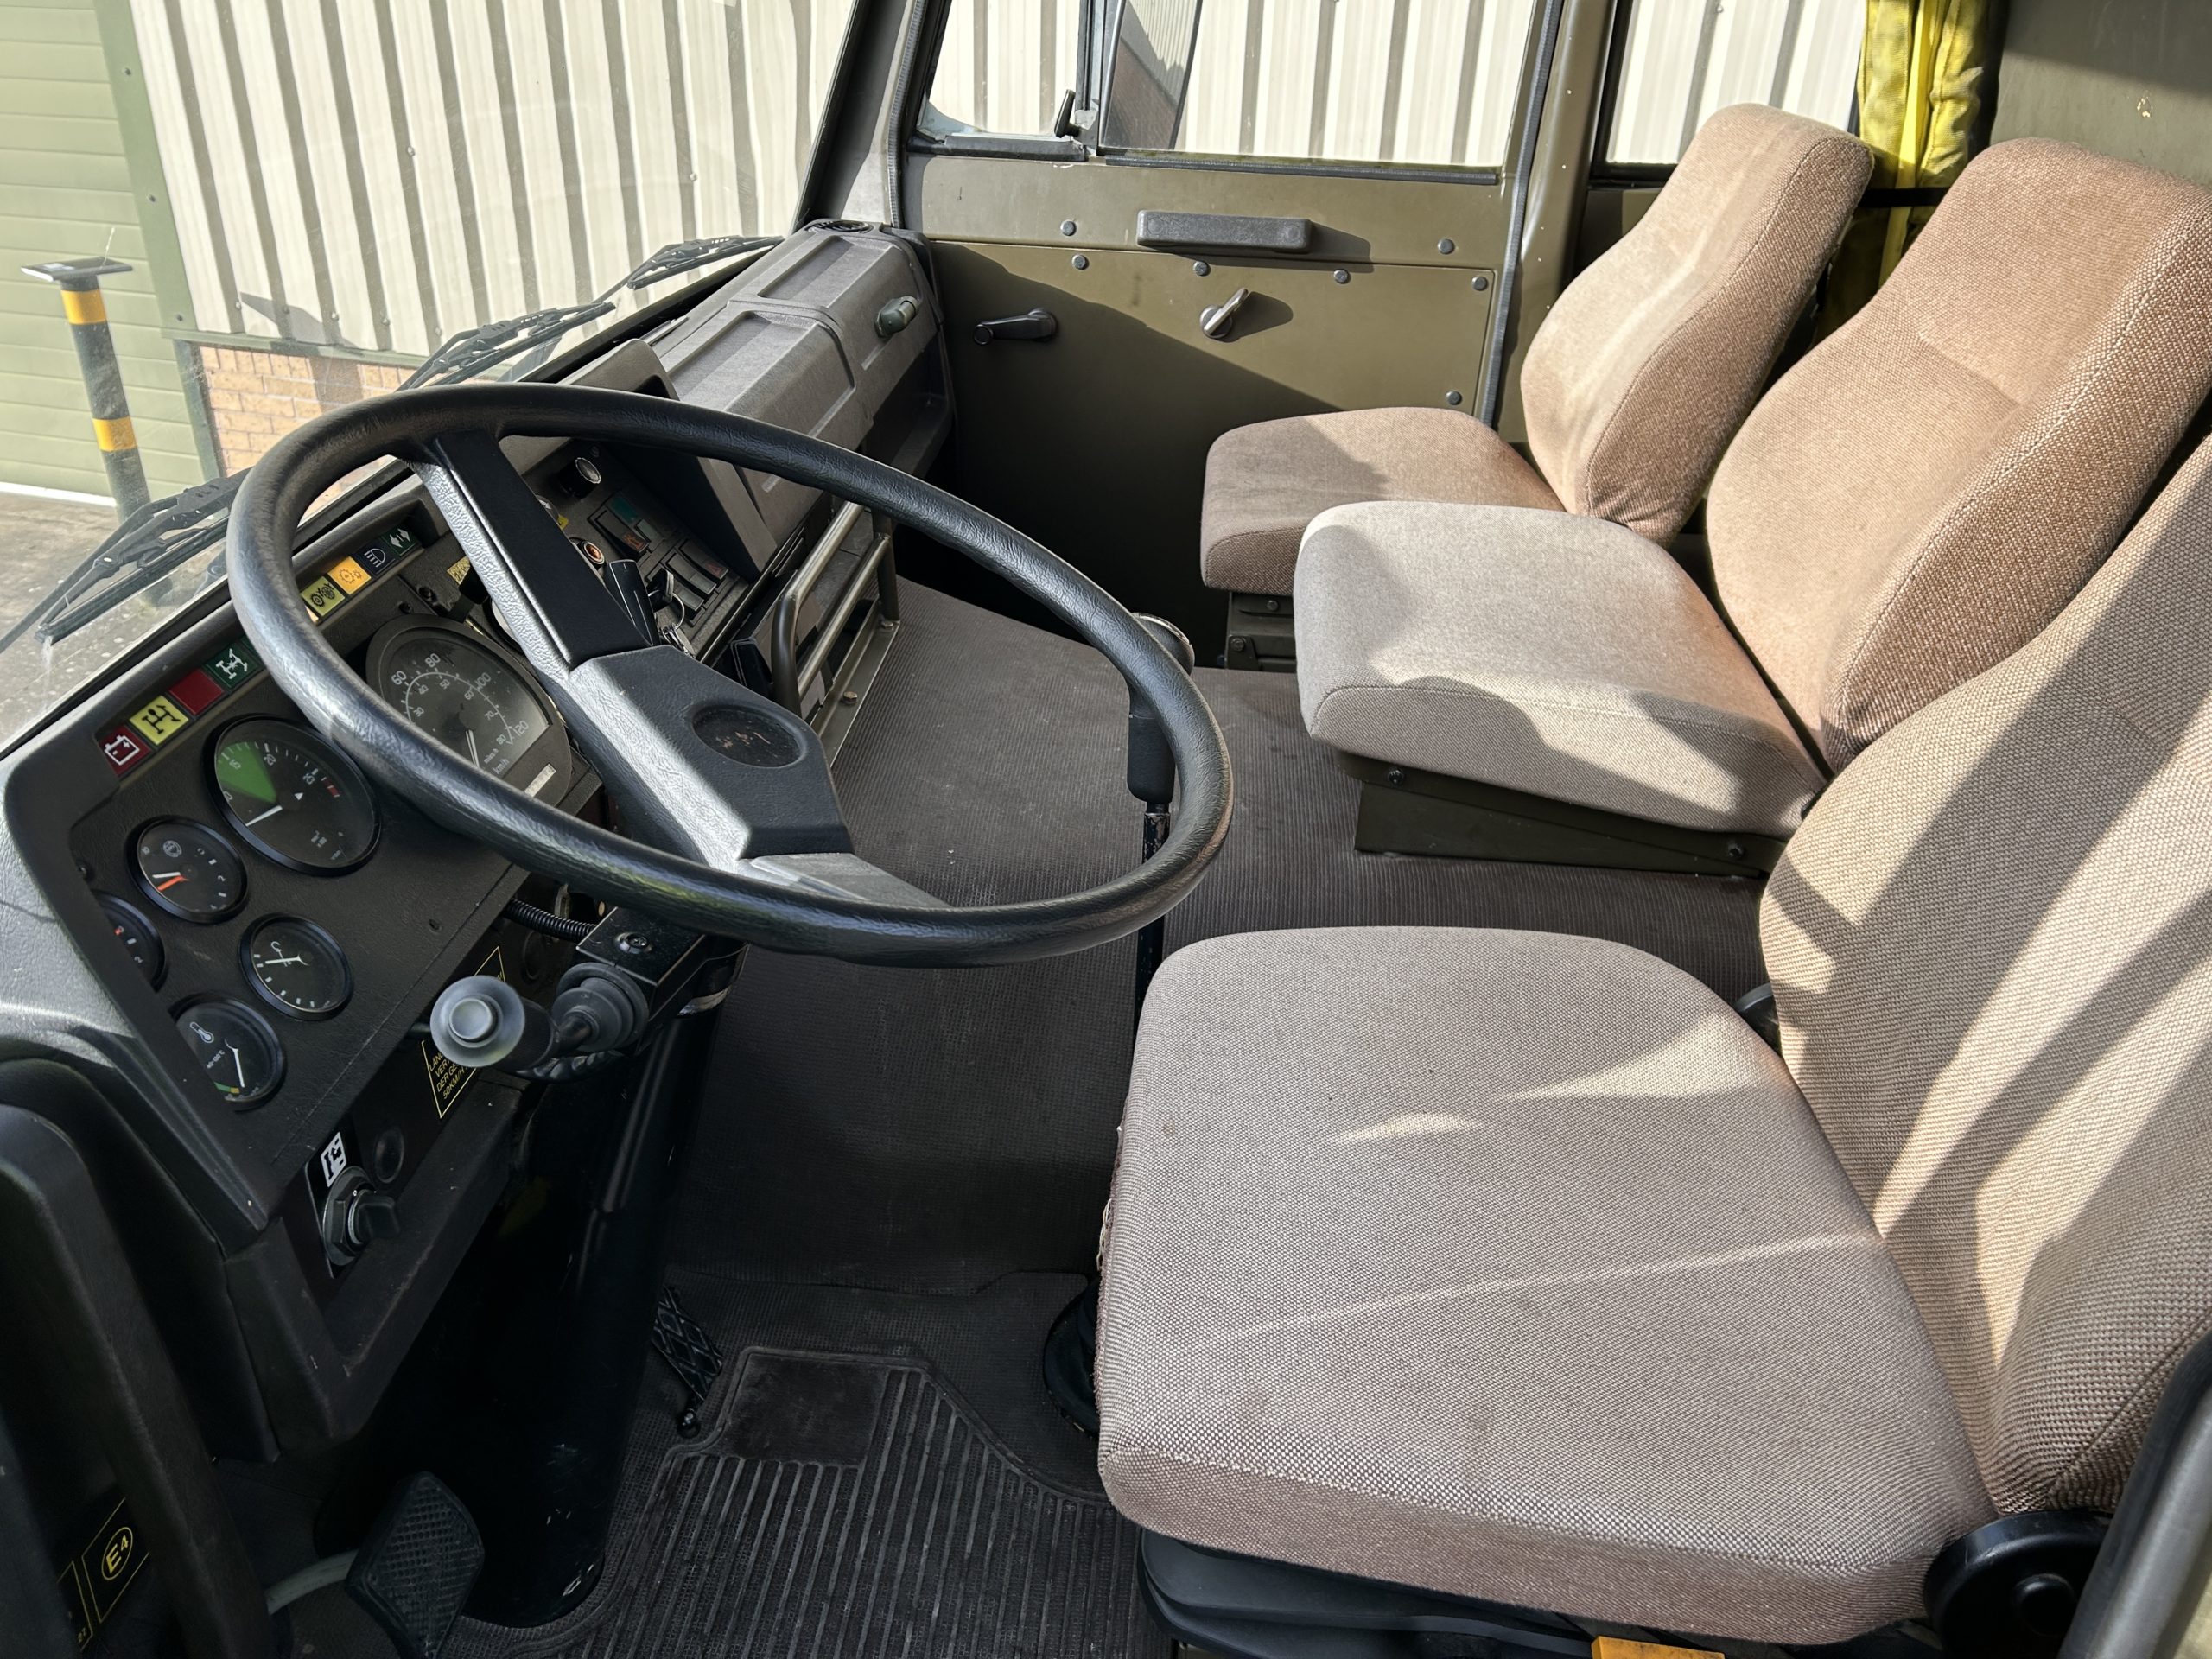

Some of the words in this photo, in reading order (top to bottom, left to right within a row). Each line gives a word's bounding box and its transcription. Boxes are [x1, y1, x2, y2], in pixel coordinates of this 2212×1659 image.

[424, 652, 441, 668] 80
[391, 670, 407, 685] 60
[475, 672, 492, 690] 100
[418, 684, 429, 696] 40
[439, 679, 450, 690] 50
[464, 690, 474, 701] 60
[413, 707, 424, 717] 30
[485, 710, 495, 721] 70
[514, 720, 530, 737] 120
[496, 734, 506, 745] 80
[264, 754, 276, 766] 20
[493, 758, 510, 775] km/h
[437, 1072, 449, 1092] DER
[105, 1535, 129, 1574] E4
